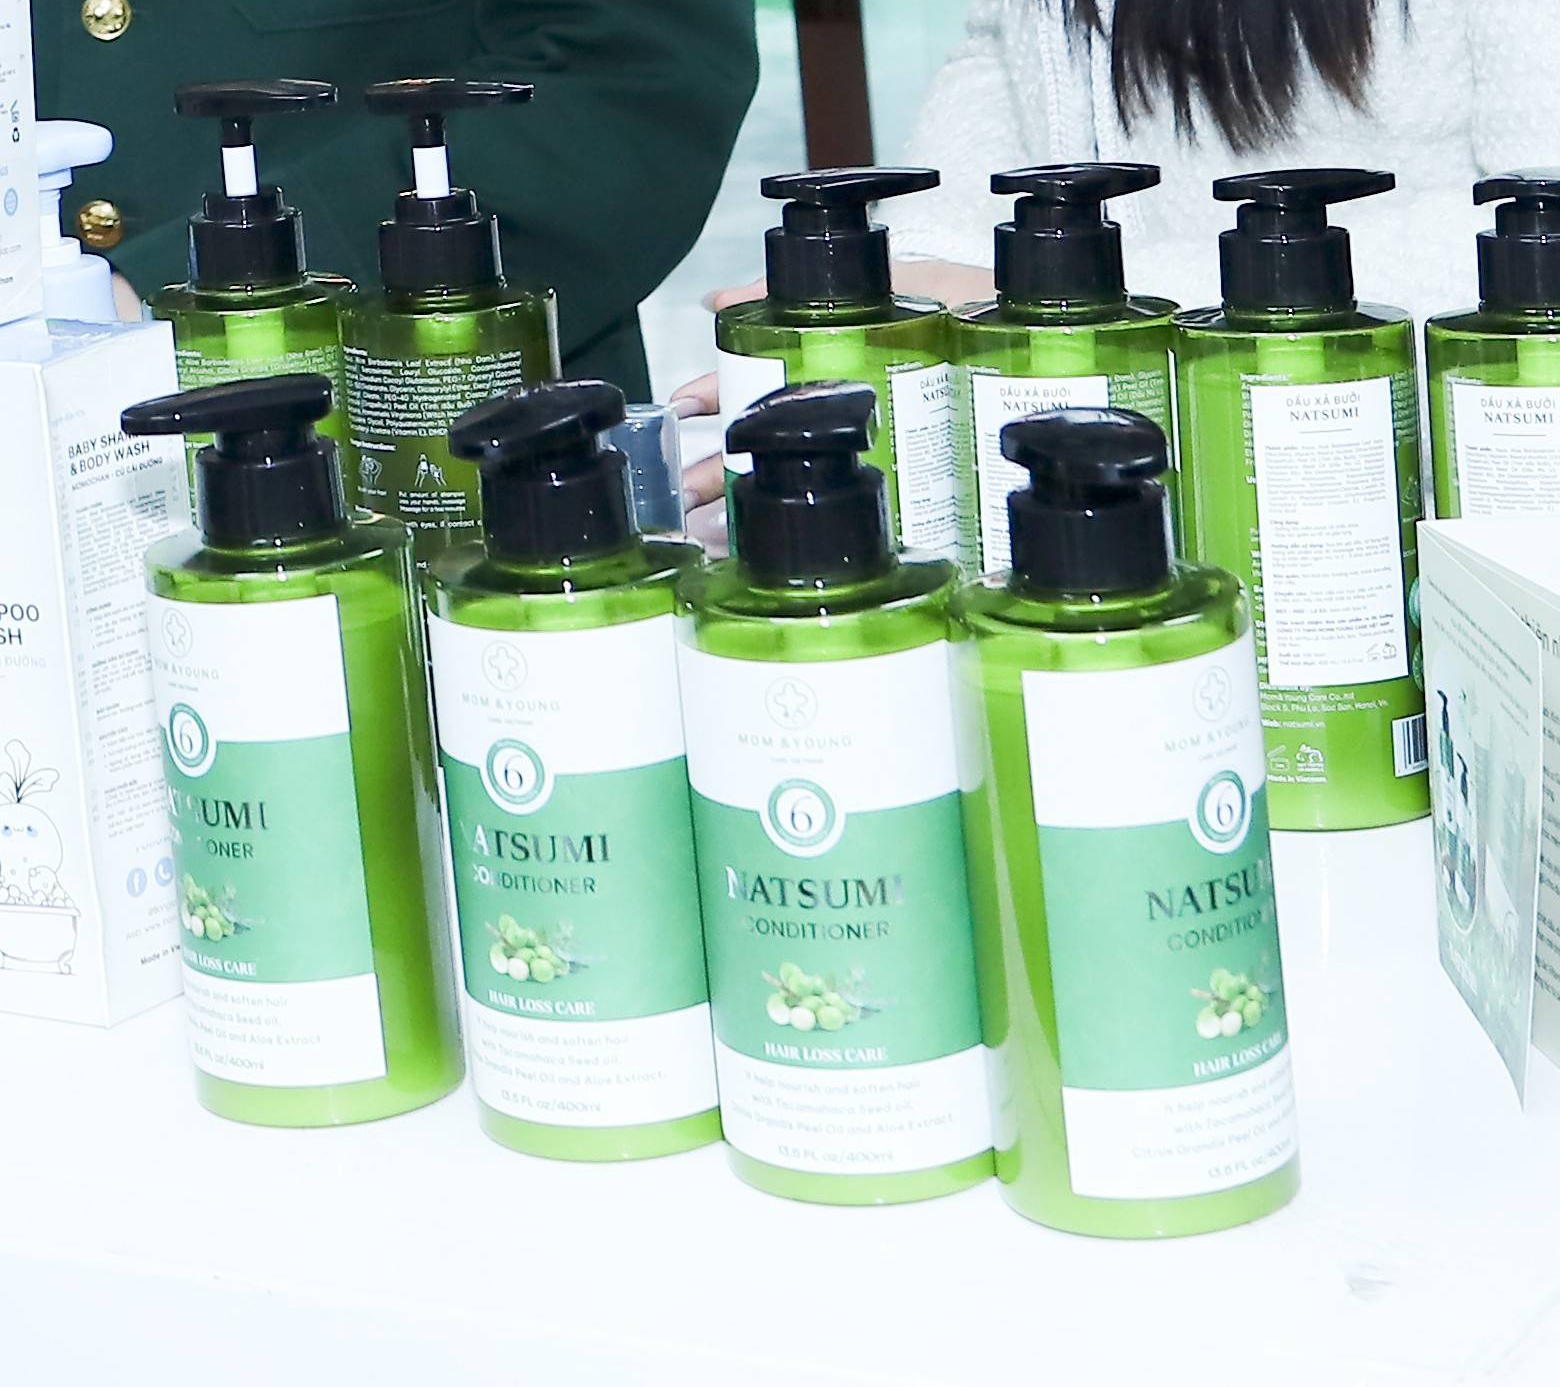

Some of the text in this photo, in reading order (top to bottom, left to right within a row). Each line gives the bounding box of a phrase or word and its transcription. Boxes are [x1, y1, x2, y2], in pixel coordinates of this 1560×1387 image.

[1290, 407, 1359, 422] NATSUMI
[1483, 412, 1554, 425] NATSUMI
[178, 718, 195, 755] 6
[503, 754, 524, 792] 6
[790, 795, 813, 834] 6
[1216, 787, 1235, 828] 6
[725, 865, 904, 910] NATSUMI
[223, 958, 257, 977] CARE
[488, 988, 595, 1016] HAIR LOSS CARE
[764, 1041, 887, 1063] HAIR LOSS CARE
[1192, 1049, 1231, 1079] HAIR
